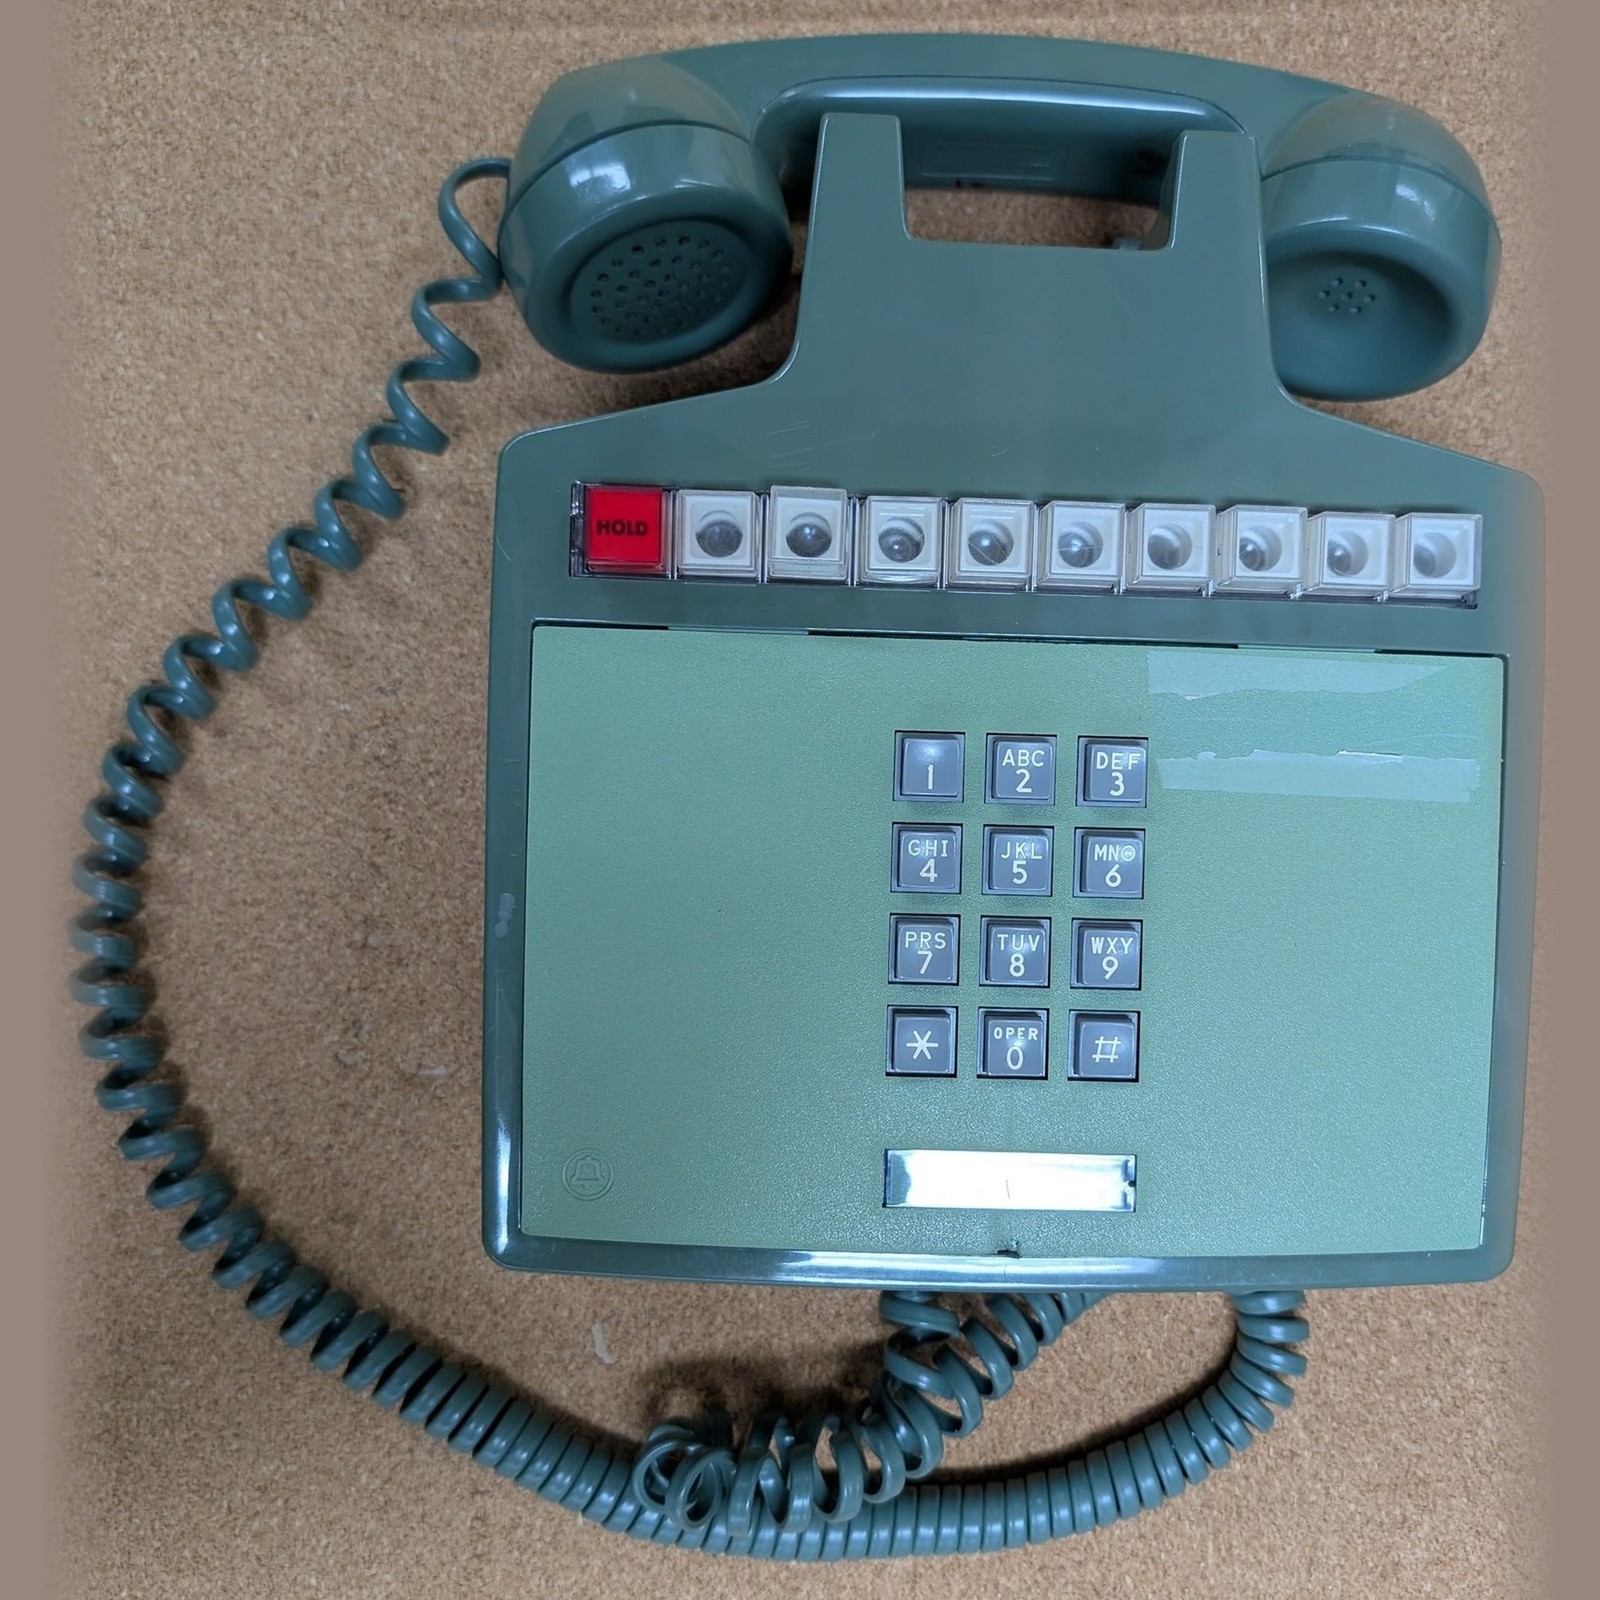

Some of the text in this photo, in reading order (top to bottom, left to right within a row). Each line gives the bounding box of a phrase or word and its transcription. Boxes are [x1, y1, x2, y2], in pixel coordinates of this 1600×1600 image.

[597, 519, 648, 536] HOLD
[1002, 749, 1045, 767] ABC
[1096, 752, 1141, 770] DEF
[927, 764, 934, 790] 1
[1015, 768, 1033, 794] 2
[1109, 772, 1125, 797] 3
[908, 839, 949, 857] GHI
[1000, 842, 1043, 860] JKL
[1094, 845, 1136, 862] MNO
[919, 859, 938, 883] 4
[1012, 860, 1027, 884] 5
[1105, 864, 1122, 888] 6
[905, 931, 946, 949] PRS
[997, 934, 1041, 952] TUV
[1091, 936, 1134, 954] WXY
[917, 951, 933, 975] 7
[1009, 953, 1025, 977] 8
[1102, 956, 1119, 980] 9
[993, 1027, 1039, 1041] OPER
[1006, 1047, 1024, 1071] 0
[1092, 1036, 1122, 1063] #
